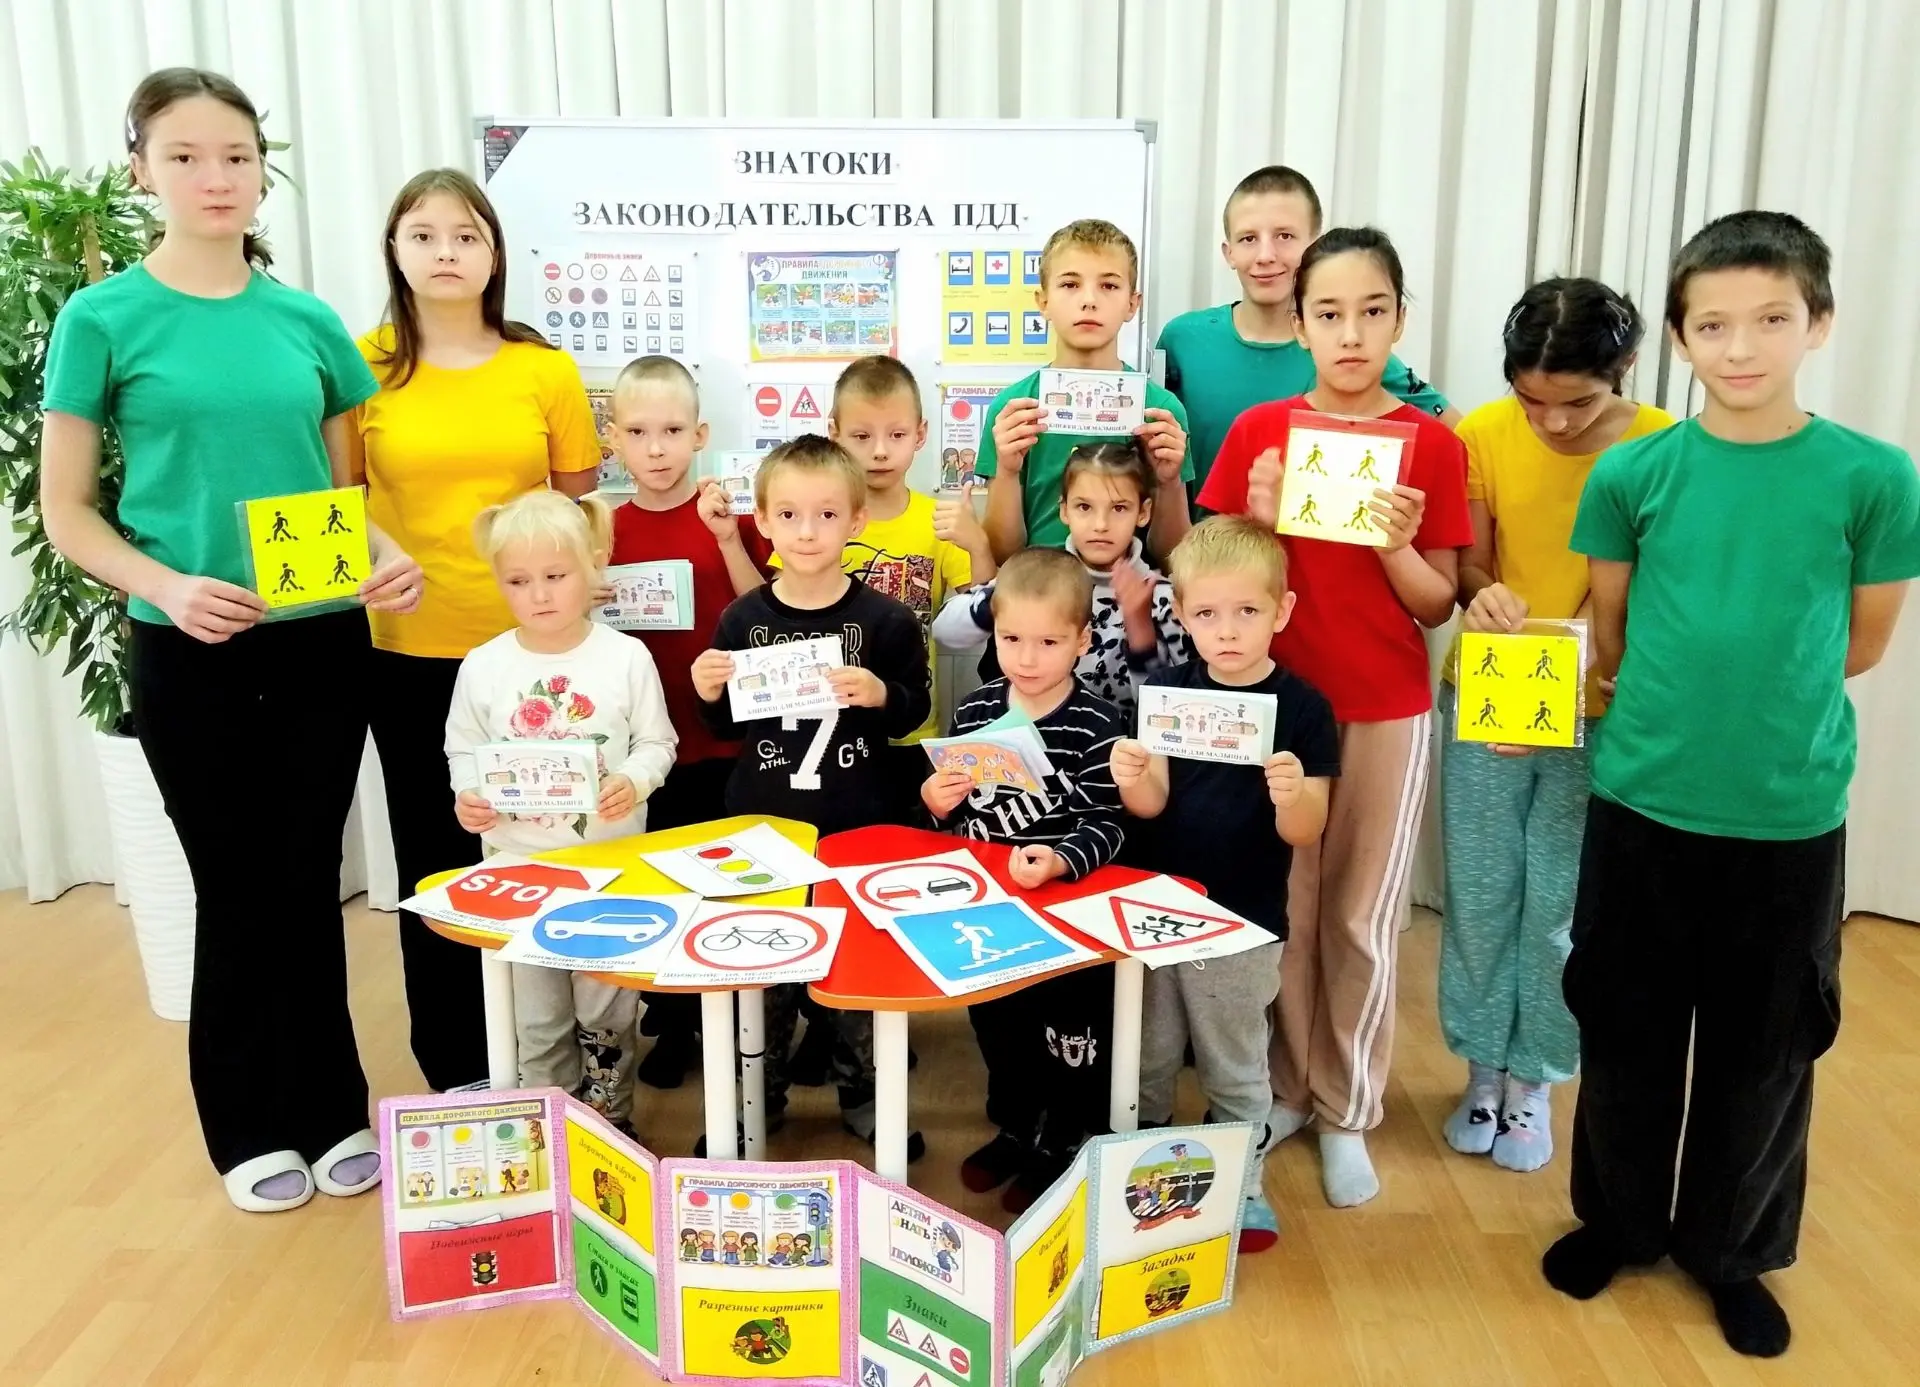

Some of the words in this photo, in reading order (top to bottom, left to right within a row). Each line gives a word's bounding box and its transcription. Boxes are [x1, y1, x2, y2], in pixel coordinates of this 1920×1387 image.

[737, 150, 892, 175] ЗНАТОКИ
[574, 202, 934, 232] ЗАКОНОДАТЕЛЬСТВА
[953, 203, 1020, 232] ПДД
[781, 260, 819, 269] ПРАВИЛА
[801, 270, 848, 279] ДВИЖЕНИЯ
[952, 387, 987, 395] ПРАВИЛА
[759, 757, 791, 771] ATHL.
[460, 874, 549, 902] STO
[403, 1114, 440, 1122] ПРАВИЛА
[443, 1110, 492, 1120] ДОРОЖНОГО
[494, 1104, 539, 1115] ДВИЖЕНИЯ
[689, 1178, 725, 1187] ПРАВИЛА
[727, 1180, 777, 1189] ДОРОЖНОГО
[779, 1181, 823, 1189] ДВИЖЕНИЯ
[891, 1200, 931, 1226] ДЕТЯМ
[430, 1233, 502, 1250] Подвижные
[506, 1226, 533, 1238] игры
[892, 1216, 931, 1240] ЗНАТЬ
[891, 1246, 952, 1284] ПОЛОЖЕНО
[1138, 1252, 1195, 1275] Загадки
[698, 1299, 759, 1313] Разрезные
[763, 1302, 824, 1315] картинки
[904, 1295, 948, 1328] Знаки
